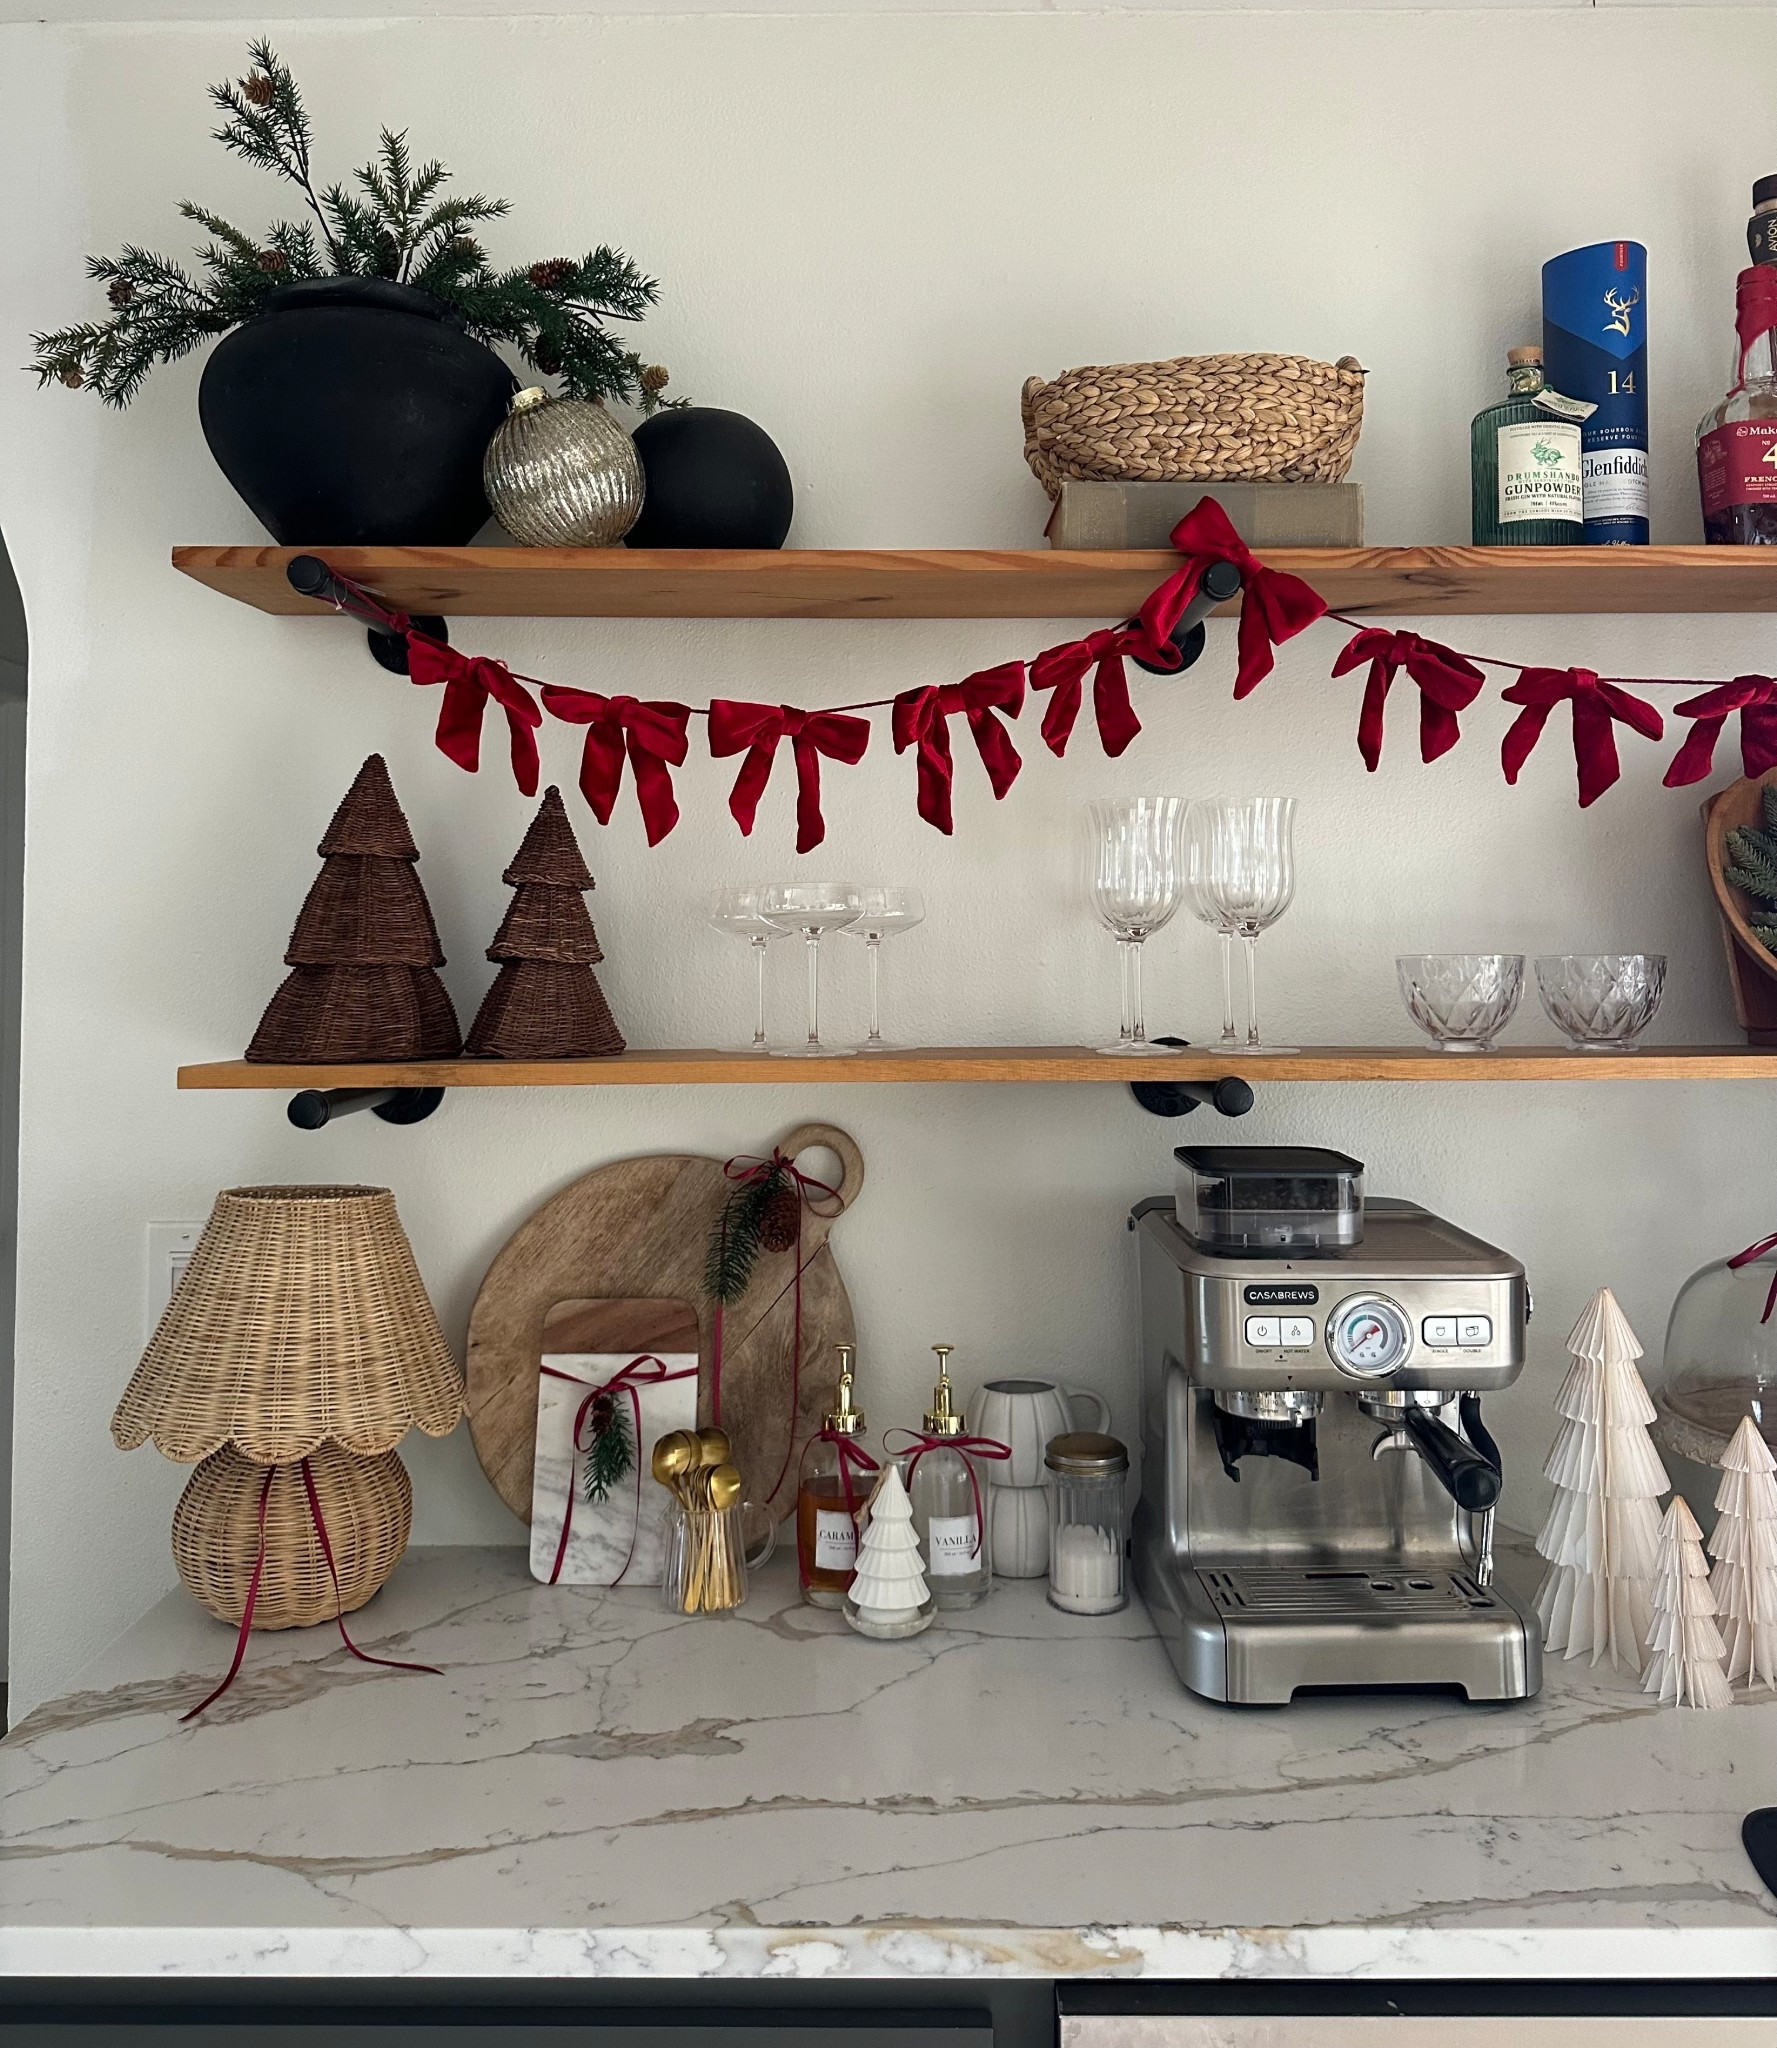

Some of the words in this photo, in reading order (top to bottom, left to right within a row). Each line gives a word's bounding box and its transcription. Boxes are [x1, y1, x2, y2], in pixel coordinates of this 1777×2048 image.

[1607, 370, 1637, 395] 14
[1600, 427, 1634, 435] BOURBON
[1749, 426, 1777, 436] Mak
[1587, 434, 1619, 443] RESERVE
[1507, 471, 1580, 482] DRUMSHANBO
[1505, 482, 1581, 496] GUNPOWDER
[1249, 1291, 1315, 1300] CASABREWS
[936, 1533, 977, 1546] VANILLA
